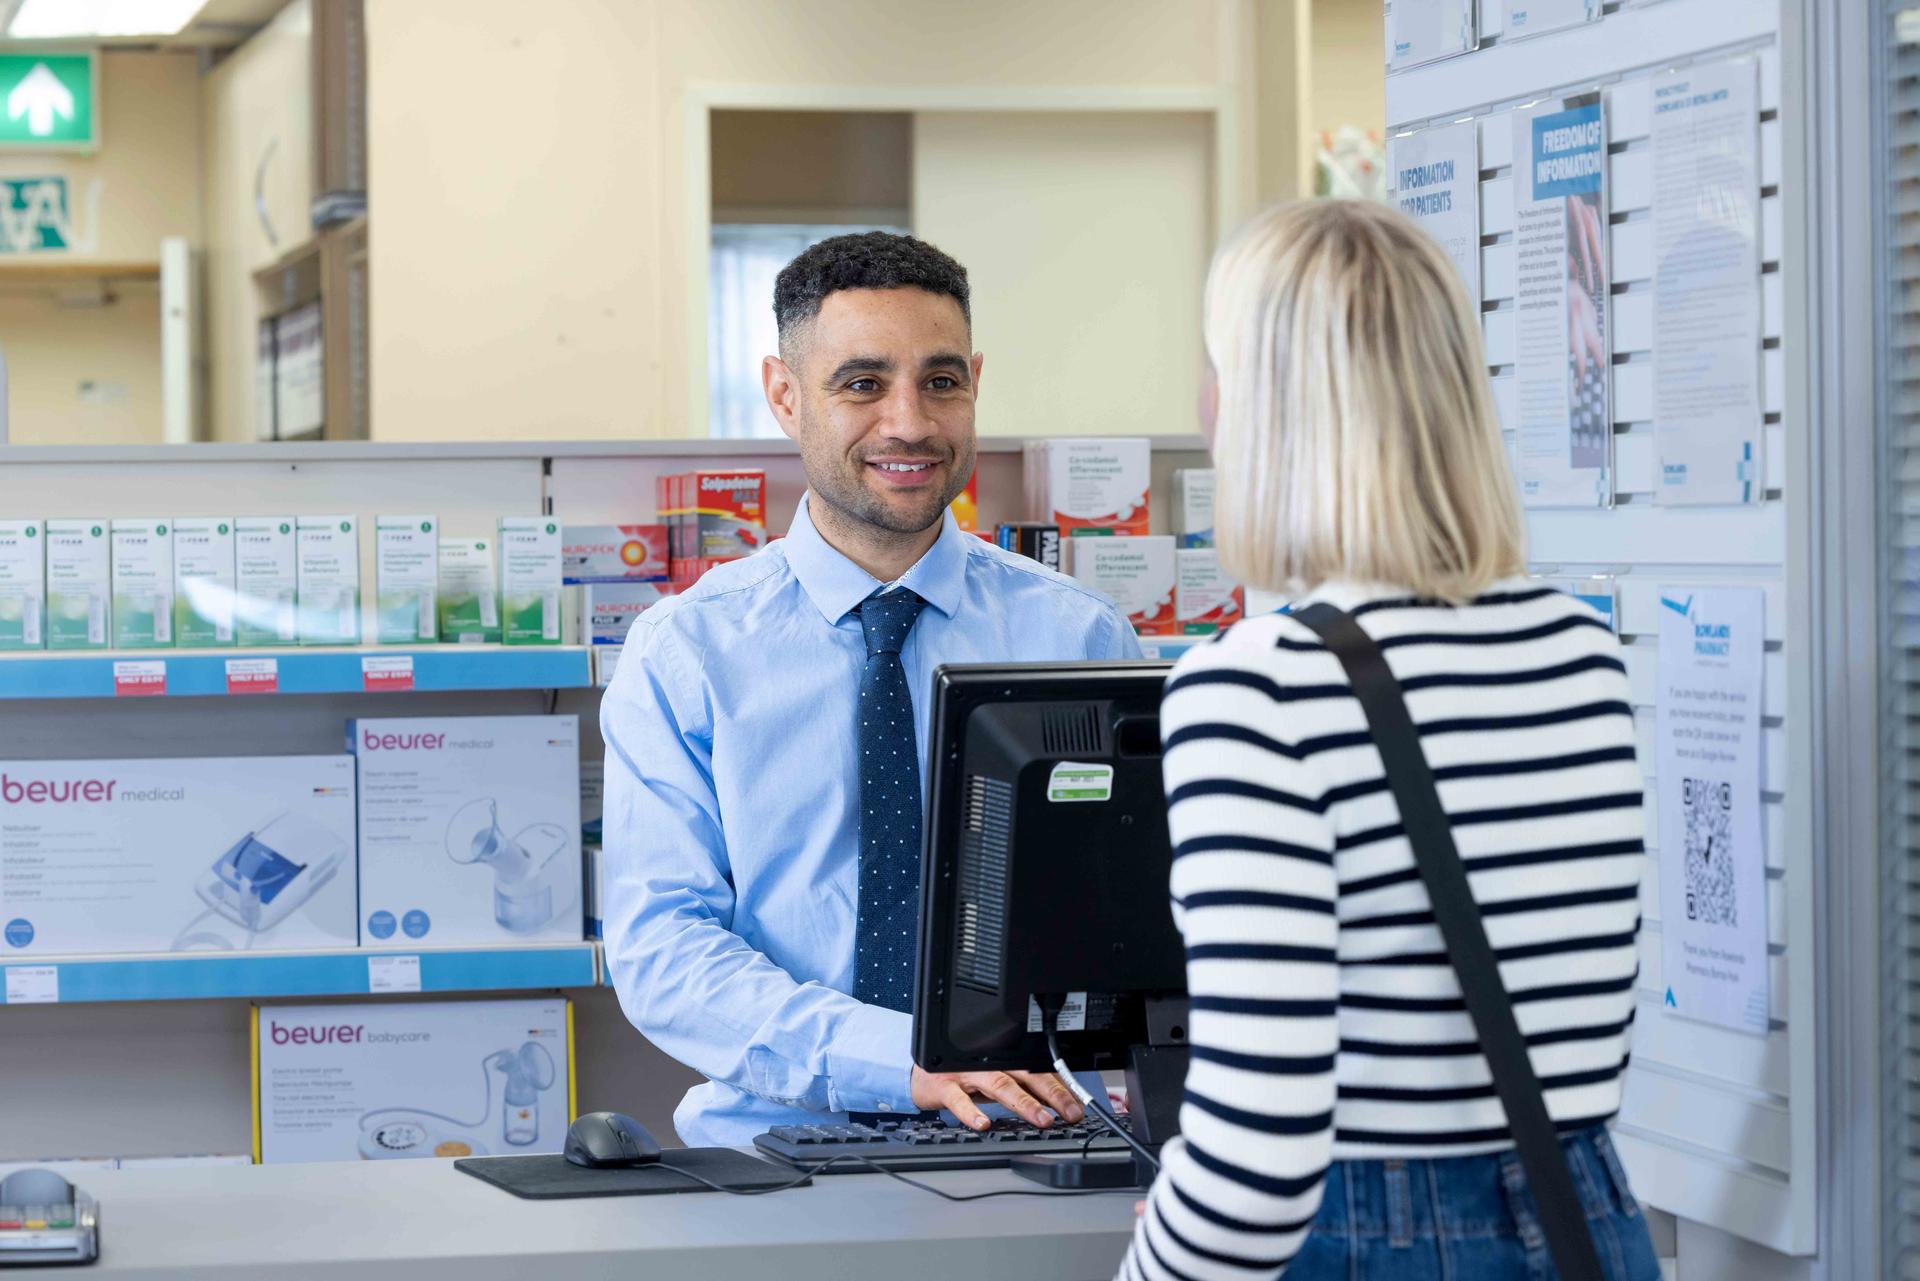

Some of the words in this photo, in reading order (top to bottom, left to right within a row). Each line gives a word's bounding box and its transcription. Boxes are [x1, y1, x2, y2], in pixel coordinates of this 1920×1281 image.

[1543, 124, 1586, 154] FREEDOM
[1586, 120, 1600, 146] OF
[1400, 160, 1455, 191] INFORMATION
[1537, 151, 1600, 184] INFORMATION
[1416, 190, 1452, 217] PATIENTS
[1069, 456, 1118, 465] Co-codamol
[1069, 466, 1122, 474] Effervescent
[1095, 554, 1144, 562] Co-codamol
[365, 729, 446, 751] beurer
[448, 739, 494, 749] medical
[1, 774, 117, 803] beurer
[121, 787, 184, 801] medical
[271, 1021, 364, 1045] beurer
[368, 1030, 431, 1044] babycare
